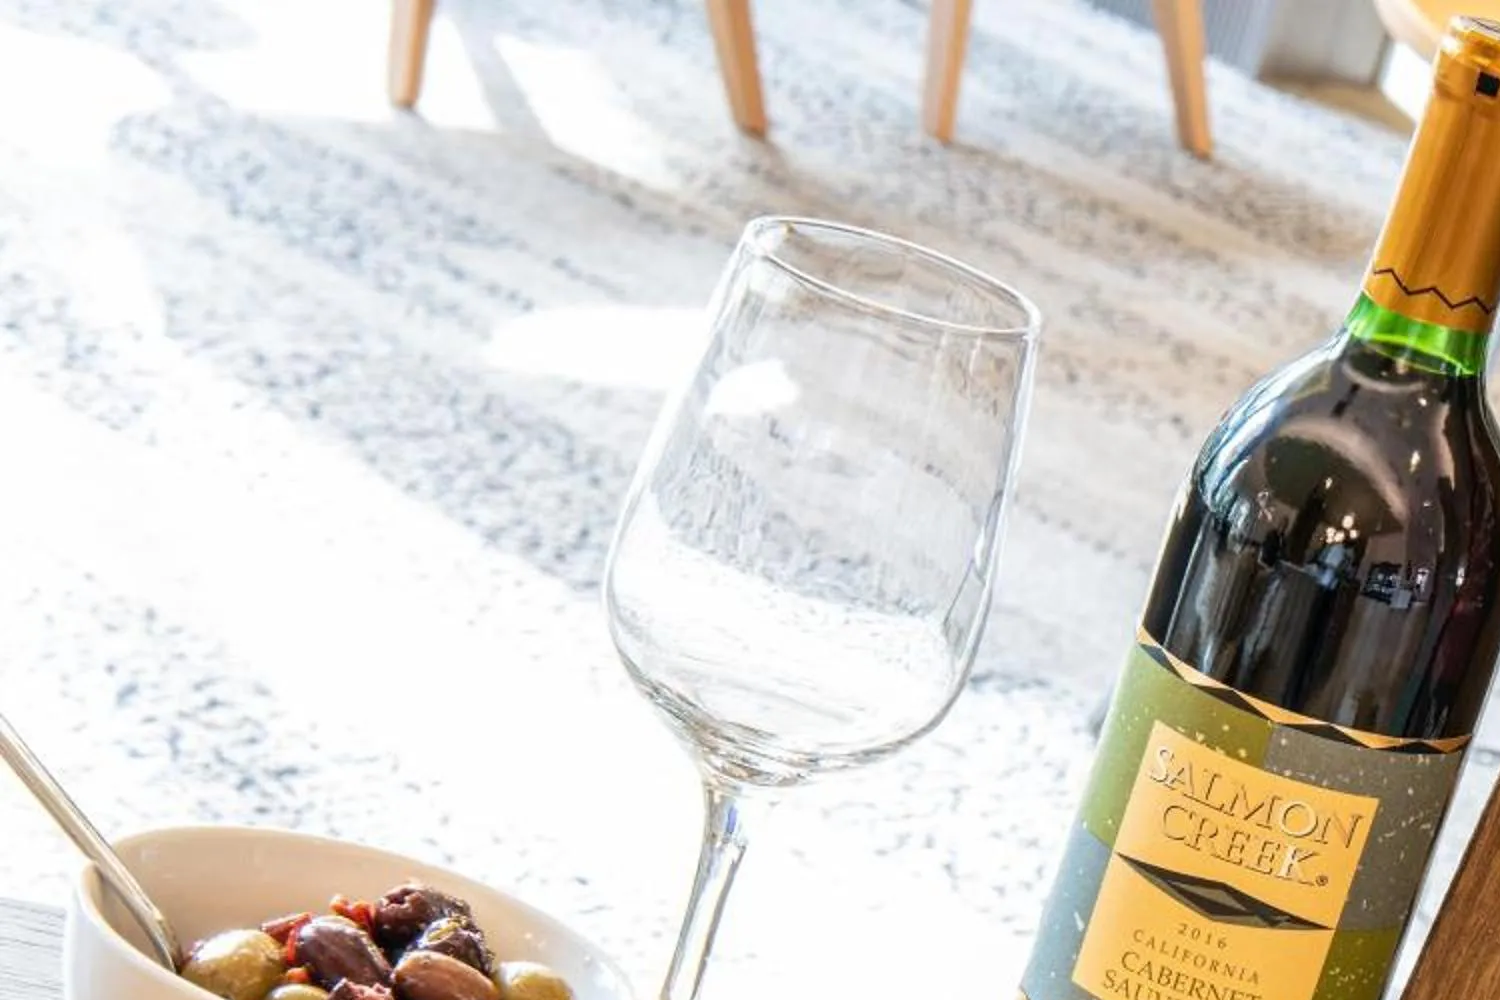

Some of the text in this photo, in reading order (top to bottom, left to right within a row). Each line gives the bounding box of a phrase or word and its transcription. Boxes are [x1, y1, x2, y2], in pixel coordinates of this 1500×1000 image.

[1149, 744, 1365, 850] SALMON
[1132, 928, 1261, 985] CALIFORNIA
[1177, 922, 1228, 949] 2016
